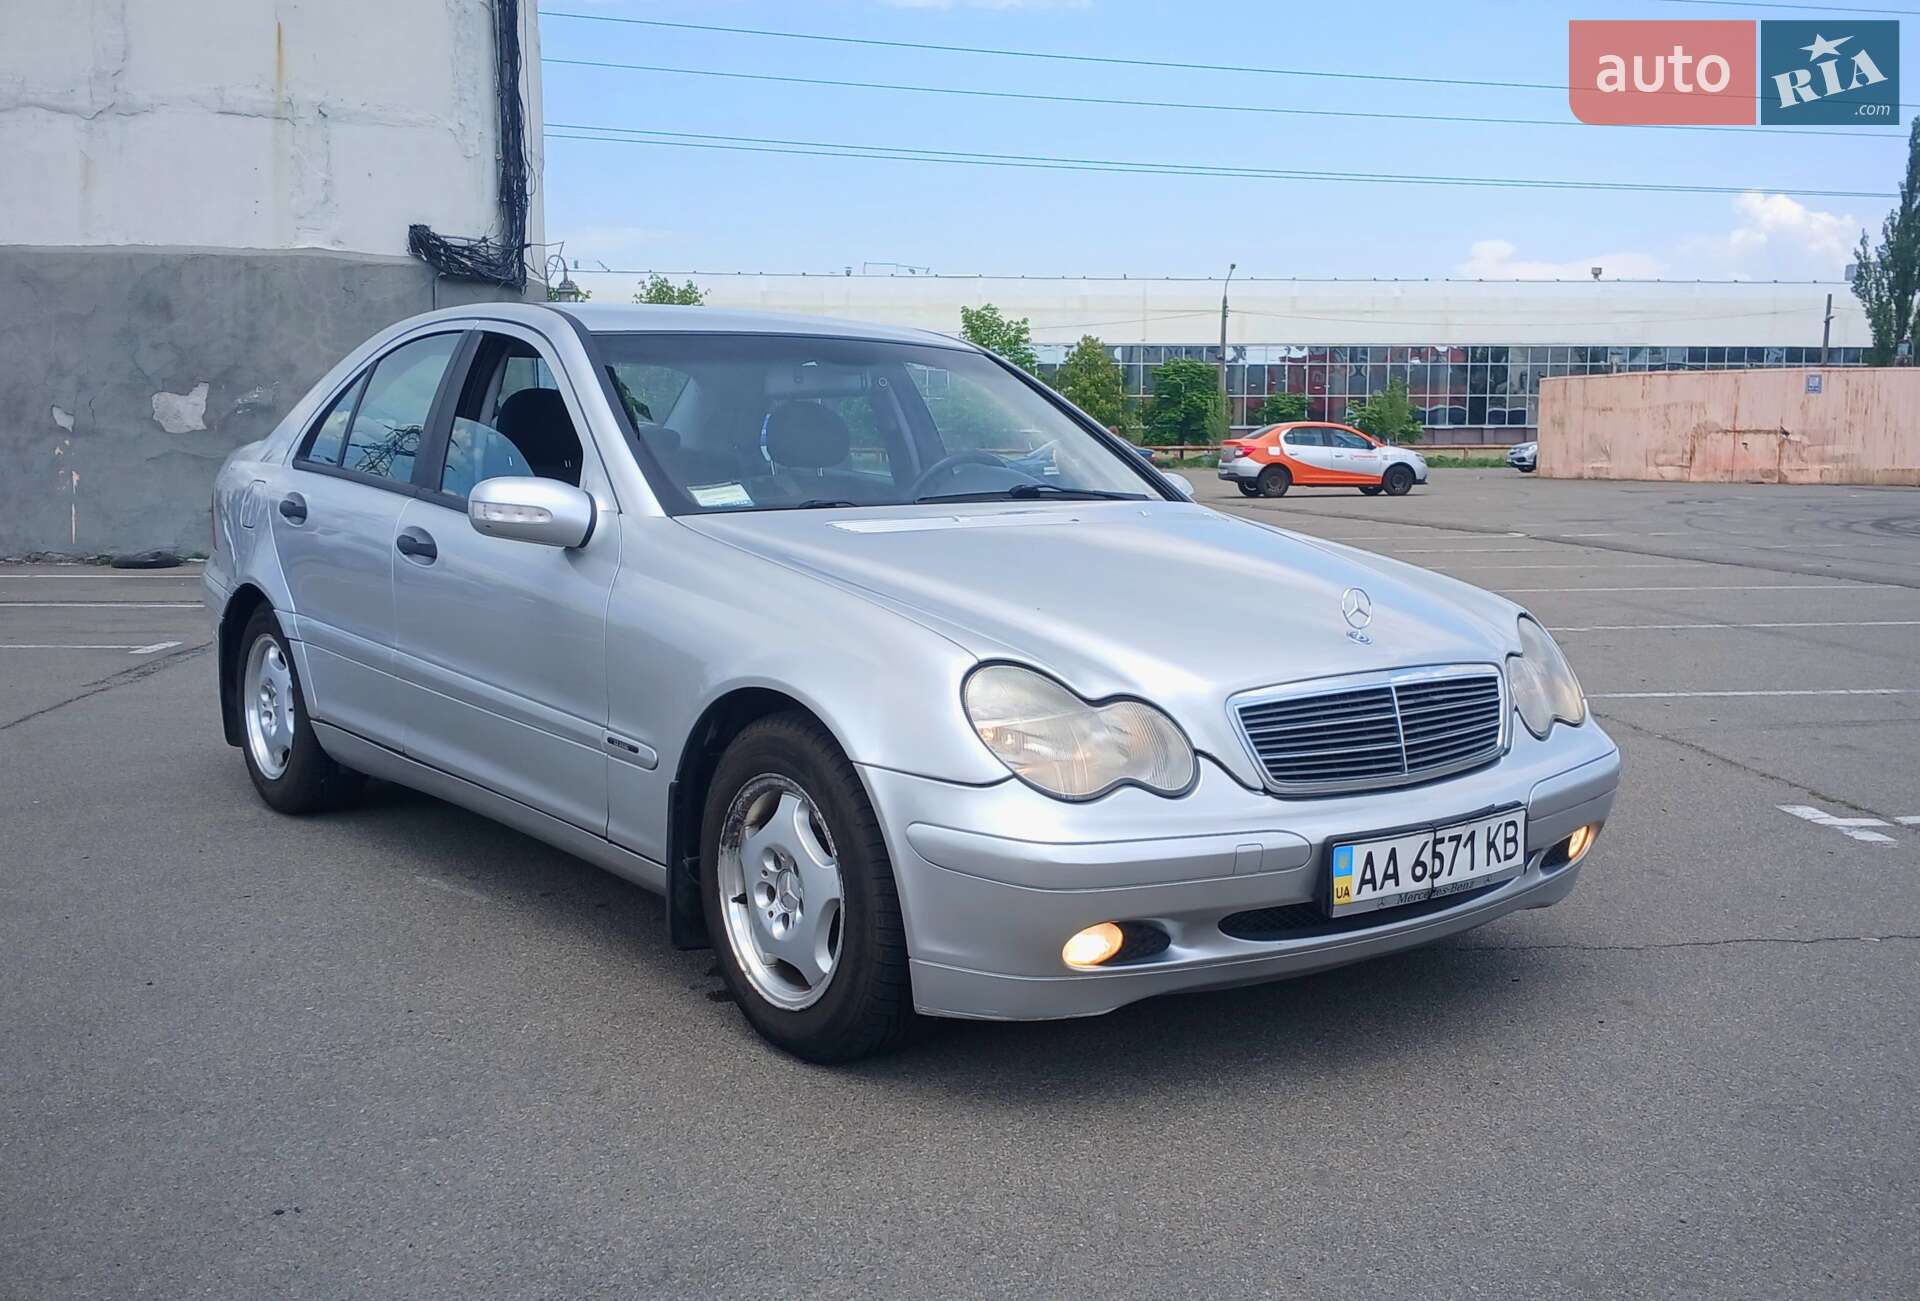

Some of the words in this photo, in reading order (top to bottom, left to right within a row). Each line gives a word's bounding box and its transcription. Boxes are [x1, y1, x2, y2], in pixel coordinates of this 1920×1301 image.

[1356, 847, 1400, 895] AA
[1411, 830, 1476, 883] 6571
[1486, 820, 1519, 867] KB
[1336, 886, 1350, 899] UA
